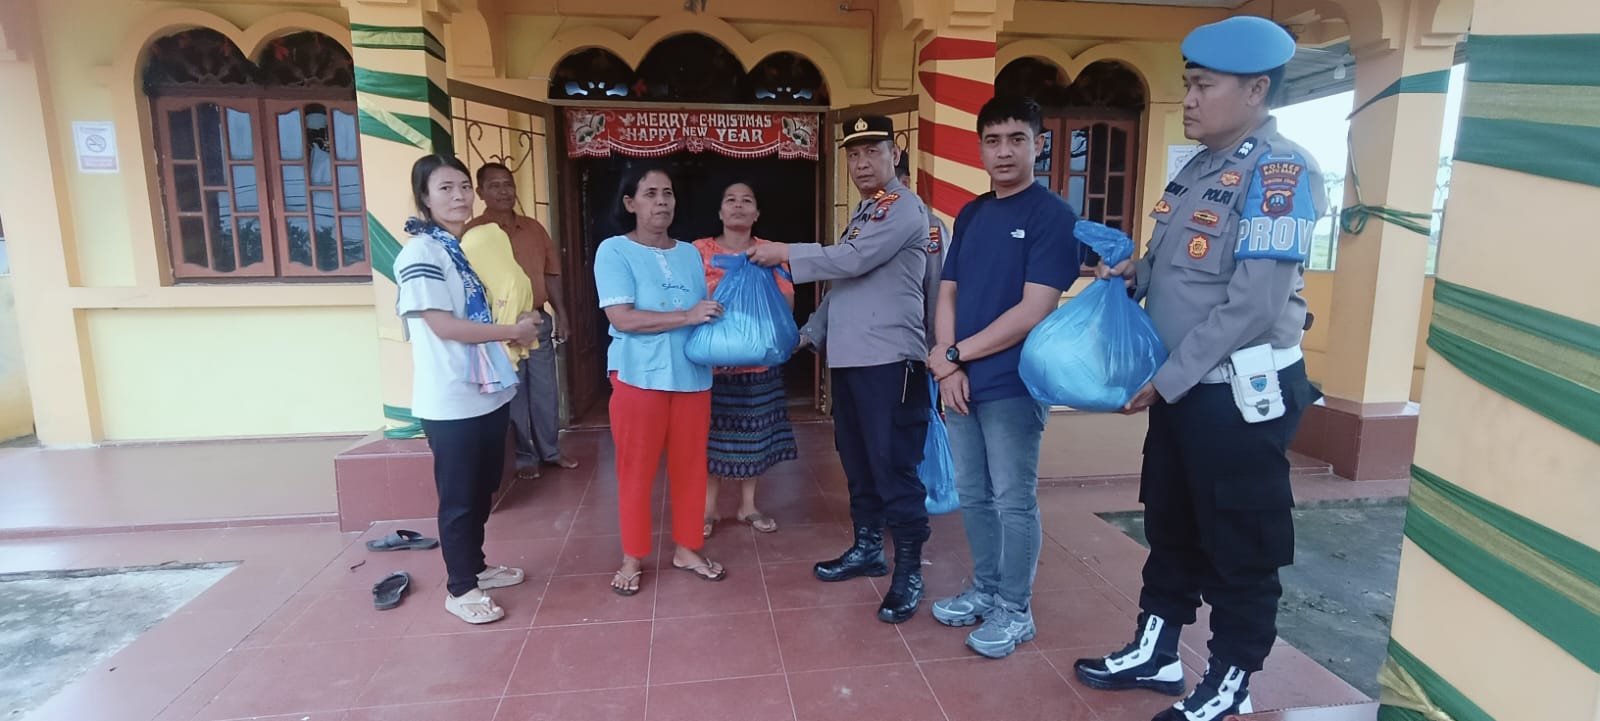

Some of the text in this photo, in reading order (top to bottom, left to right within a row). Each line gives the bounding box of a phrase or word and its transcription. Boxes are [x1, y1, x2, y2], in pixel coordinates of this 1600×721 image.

[636, 112, 772, 128] MERRY CHRISTMAS
[626, 127, 764, 144] HAPPY NEW YEAR
[1203, 188, 1234, 204] POLRI
[1235, 216, 1314, 254] PROV
